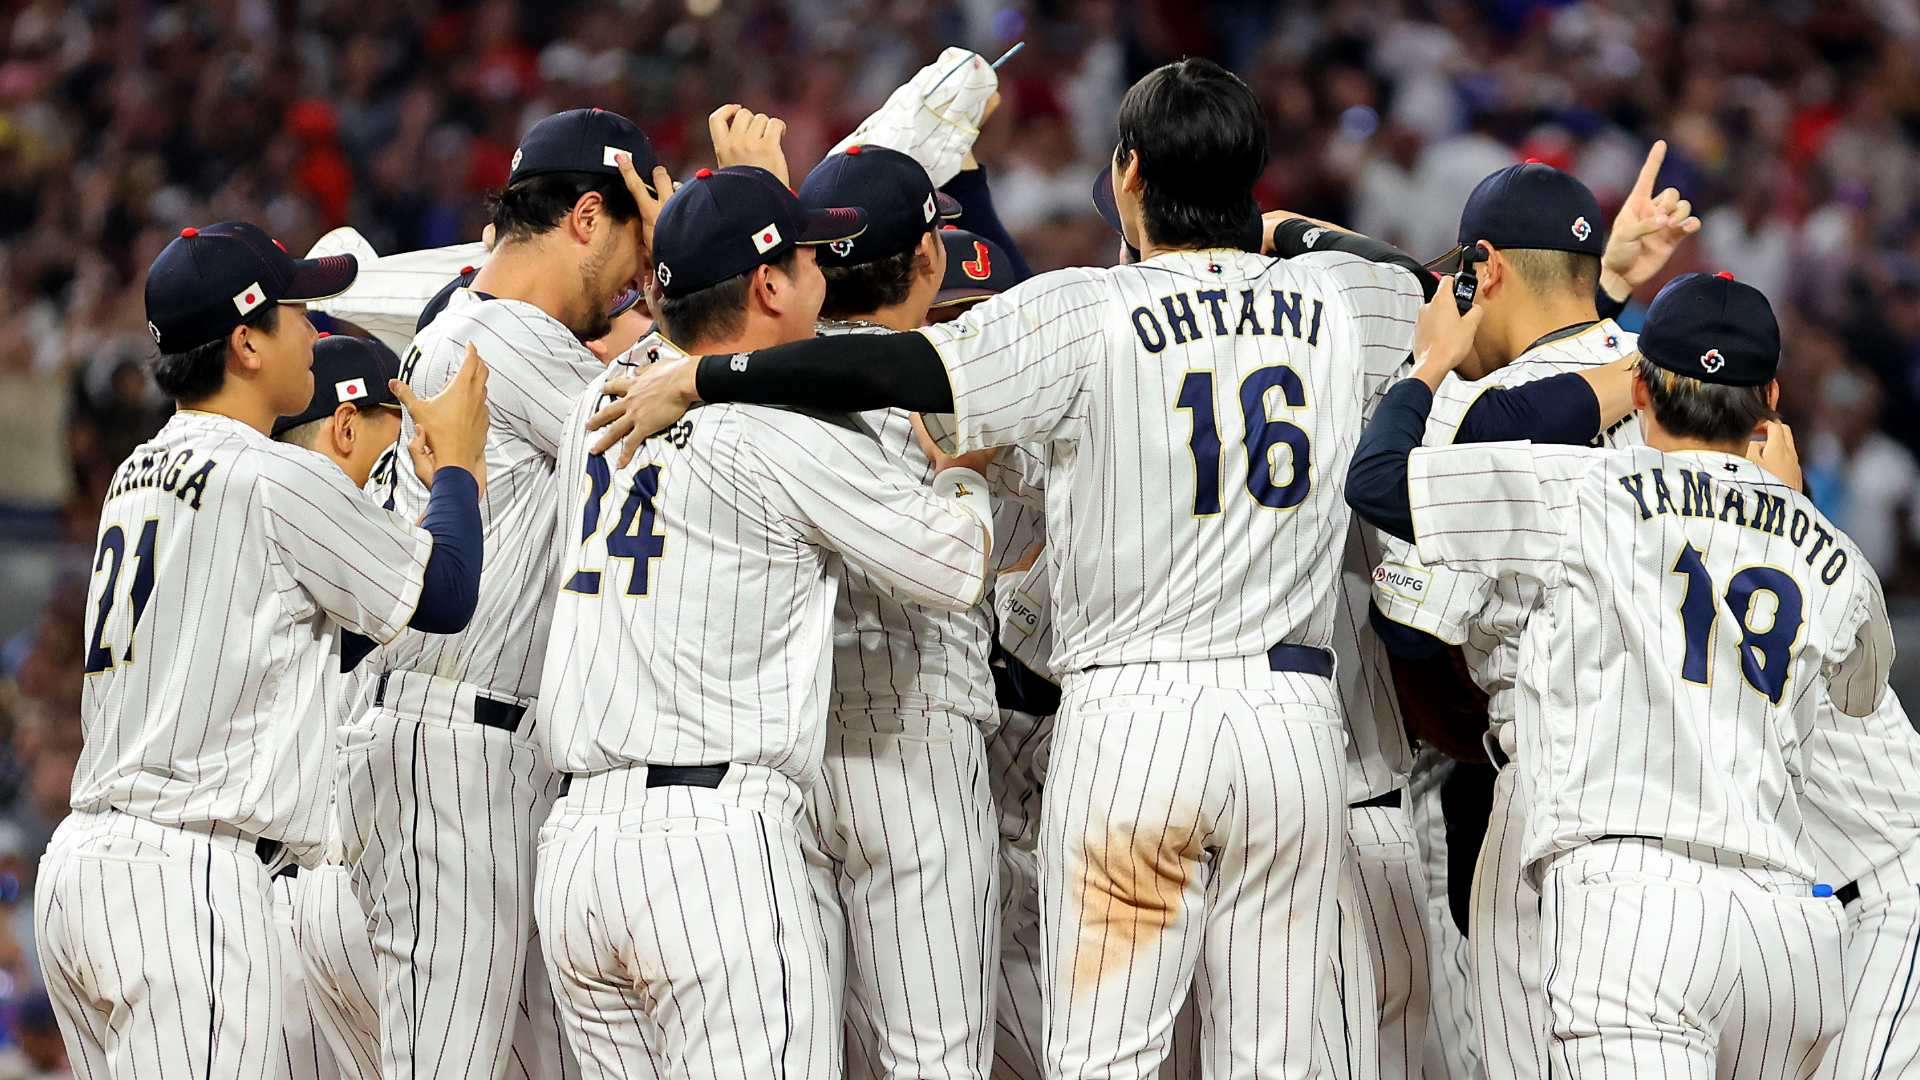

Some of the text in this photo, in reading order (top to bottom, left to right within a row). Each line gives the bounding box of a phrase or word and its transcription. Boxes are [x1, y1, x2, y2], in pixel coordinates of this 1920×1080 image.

[962, 240, 991, 280] J
[1131, 288, 1324, 354] OHTANI
[1175, 361, 1313, 518] 16
[561, 451, 667, 597] 24
[1386, 571, 1423, 592] MUFG
[1618, 467, 1848, 586] YAMAMOTO
[84, 516, 160, 676] 21
[1672, 540, 1806, 706] 18
